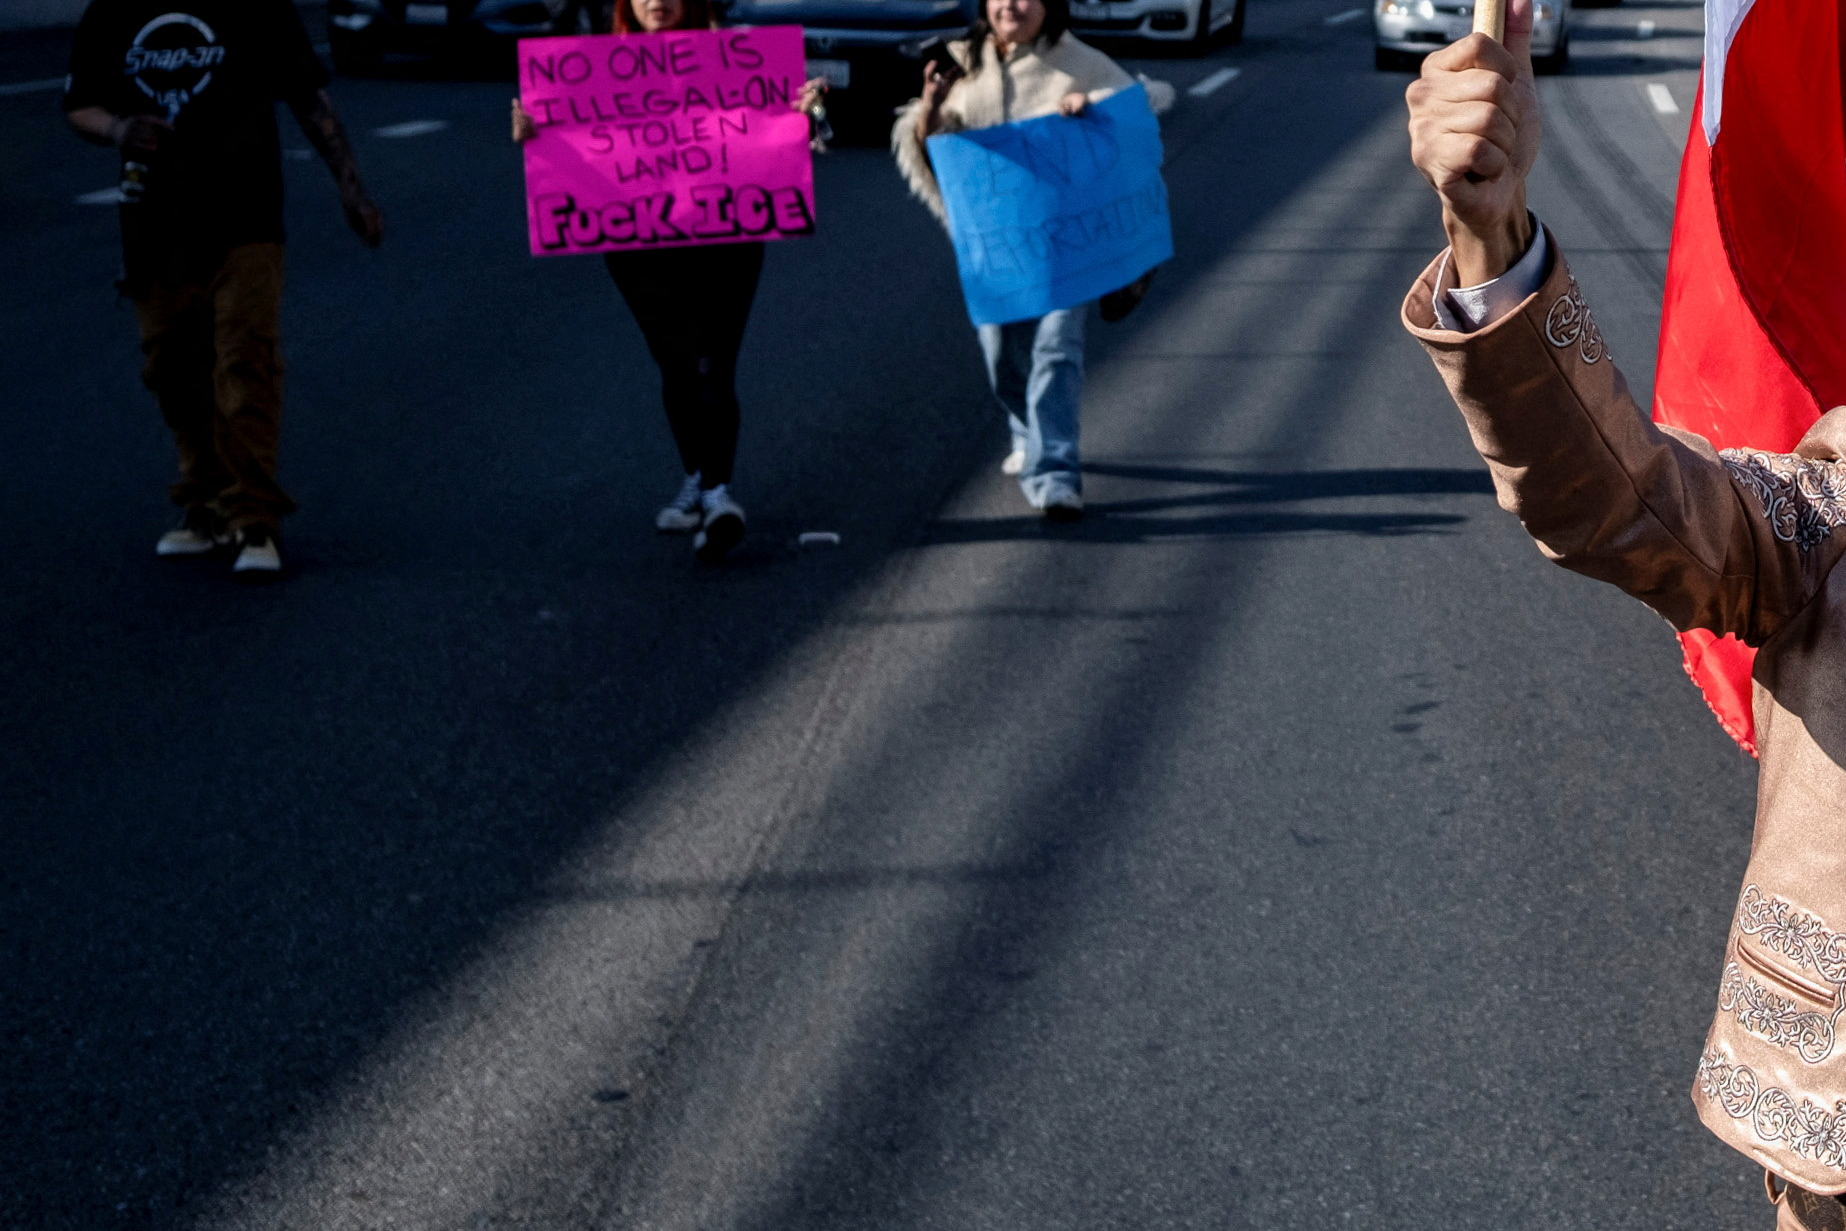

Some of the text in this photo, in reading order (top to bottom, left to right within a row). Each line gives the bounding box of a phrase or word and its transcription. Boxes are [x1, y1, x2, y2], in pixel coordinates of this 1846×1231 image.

[528, 34, 765, 86] NO ONE IS
[588, 112, 749, 155] STOLEN
[615, 146, 729, 184] LAND!
[690, 183, 816, 238] ICE
